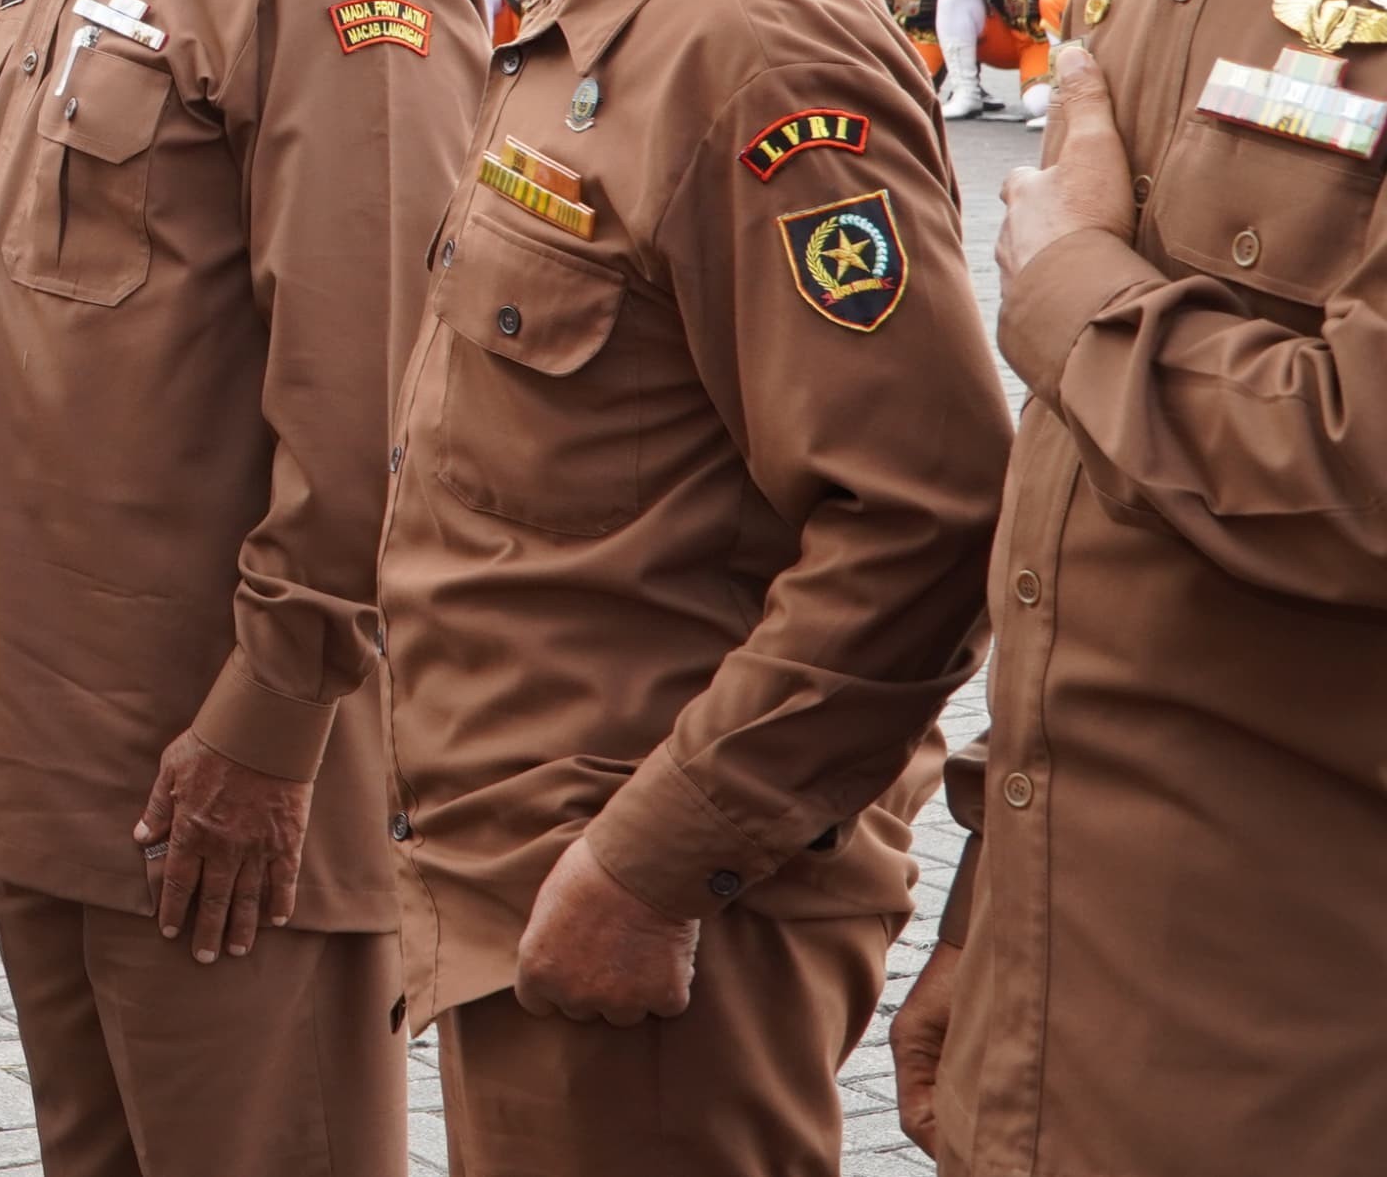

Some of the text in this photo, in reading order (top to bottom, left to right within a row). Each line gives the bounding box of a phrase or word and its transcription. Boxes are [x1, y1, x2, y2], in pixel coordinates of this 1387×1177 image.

[339, 3, 372, 23] MADA
[373, 1, 400, 17] PROV
[347, 23, 382, 44] MACAB
[758, 116, 849, 163] LVRI
